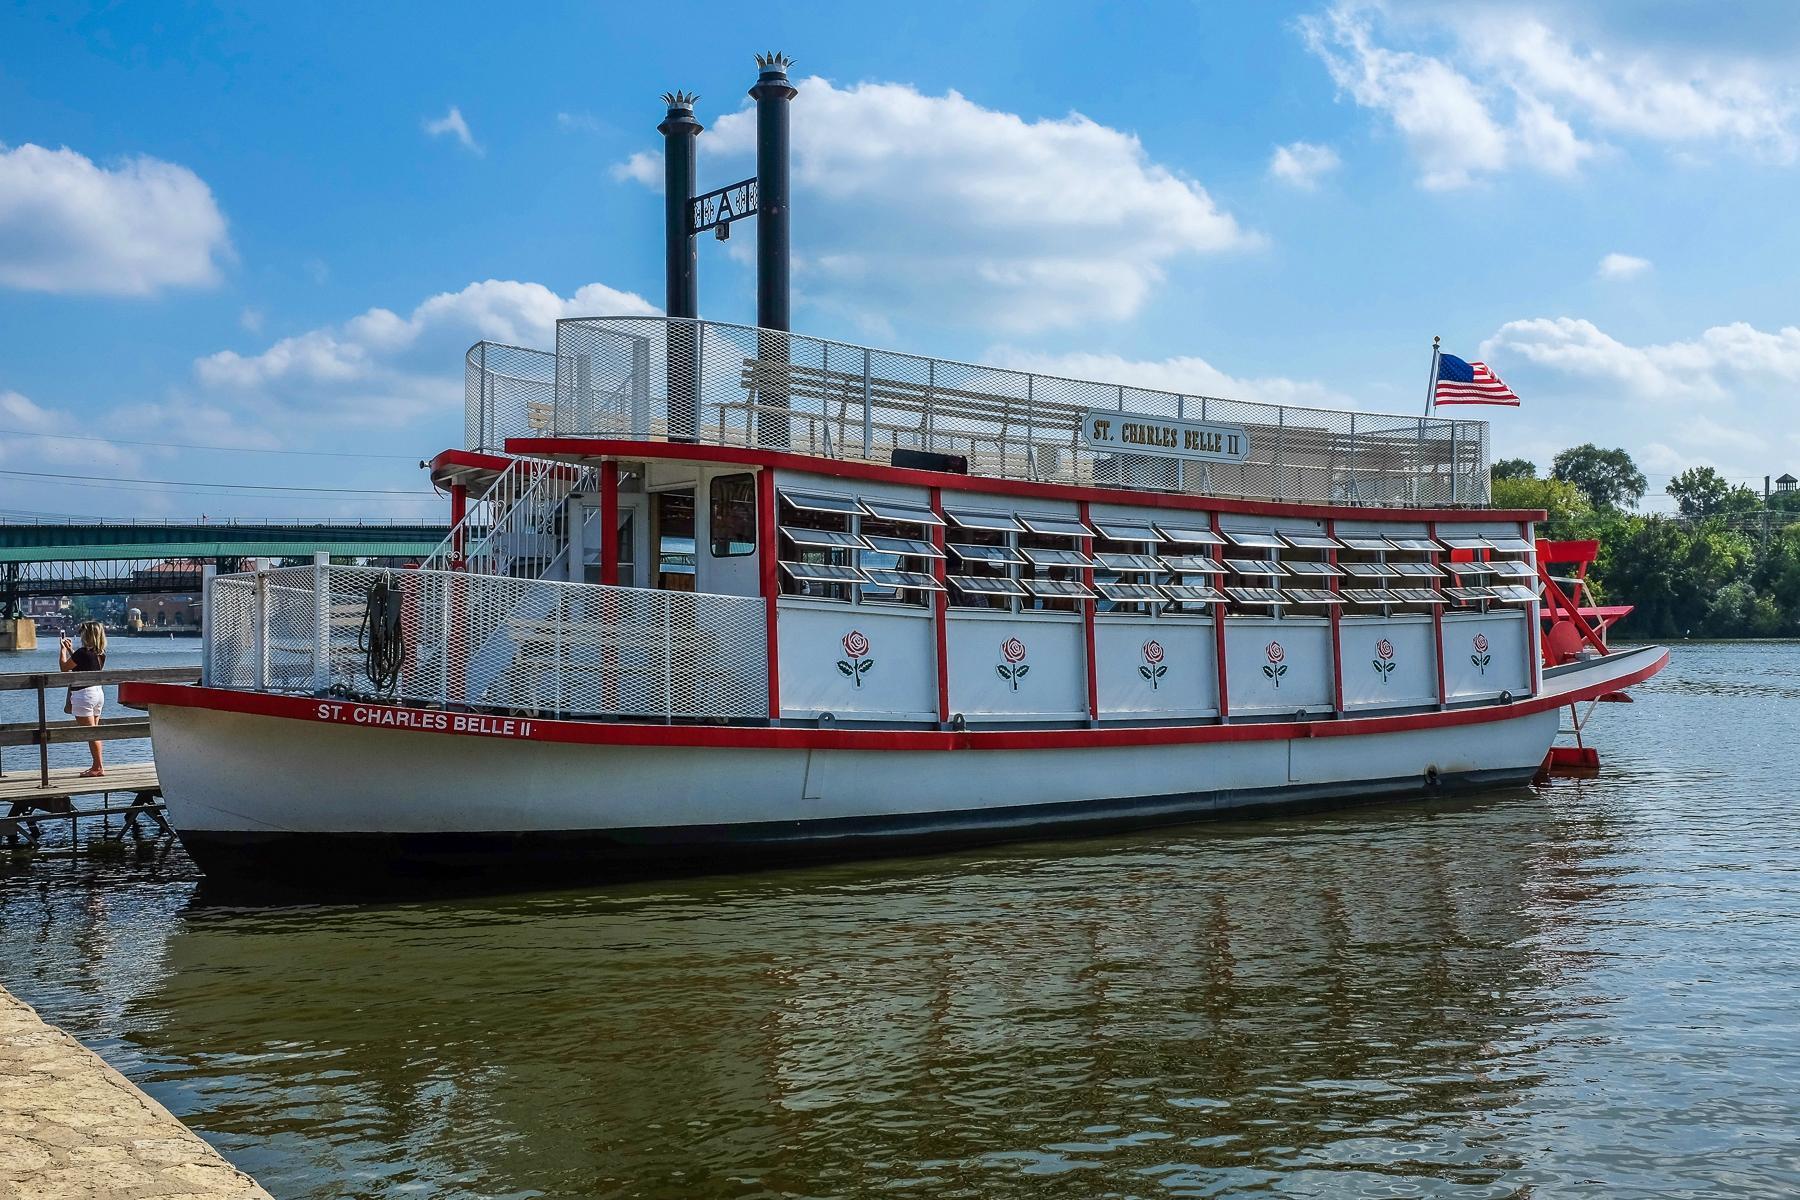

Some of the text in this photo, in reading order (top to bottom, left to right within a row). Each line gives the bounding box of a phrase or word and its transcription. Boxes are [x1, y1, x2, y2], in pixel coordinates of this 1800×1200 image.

[716, 192, 736, 222] A
[1093, 419, 1240, 455] ST. CHARLES BELLE II
[317, 703, 530, 737] ST. CHARLES BELLE II
